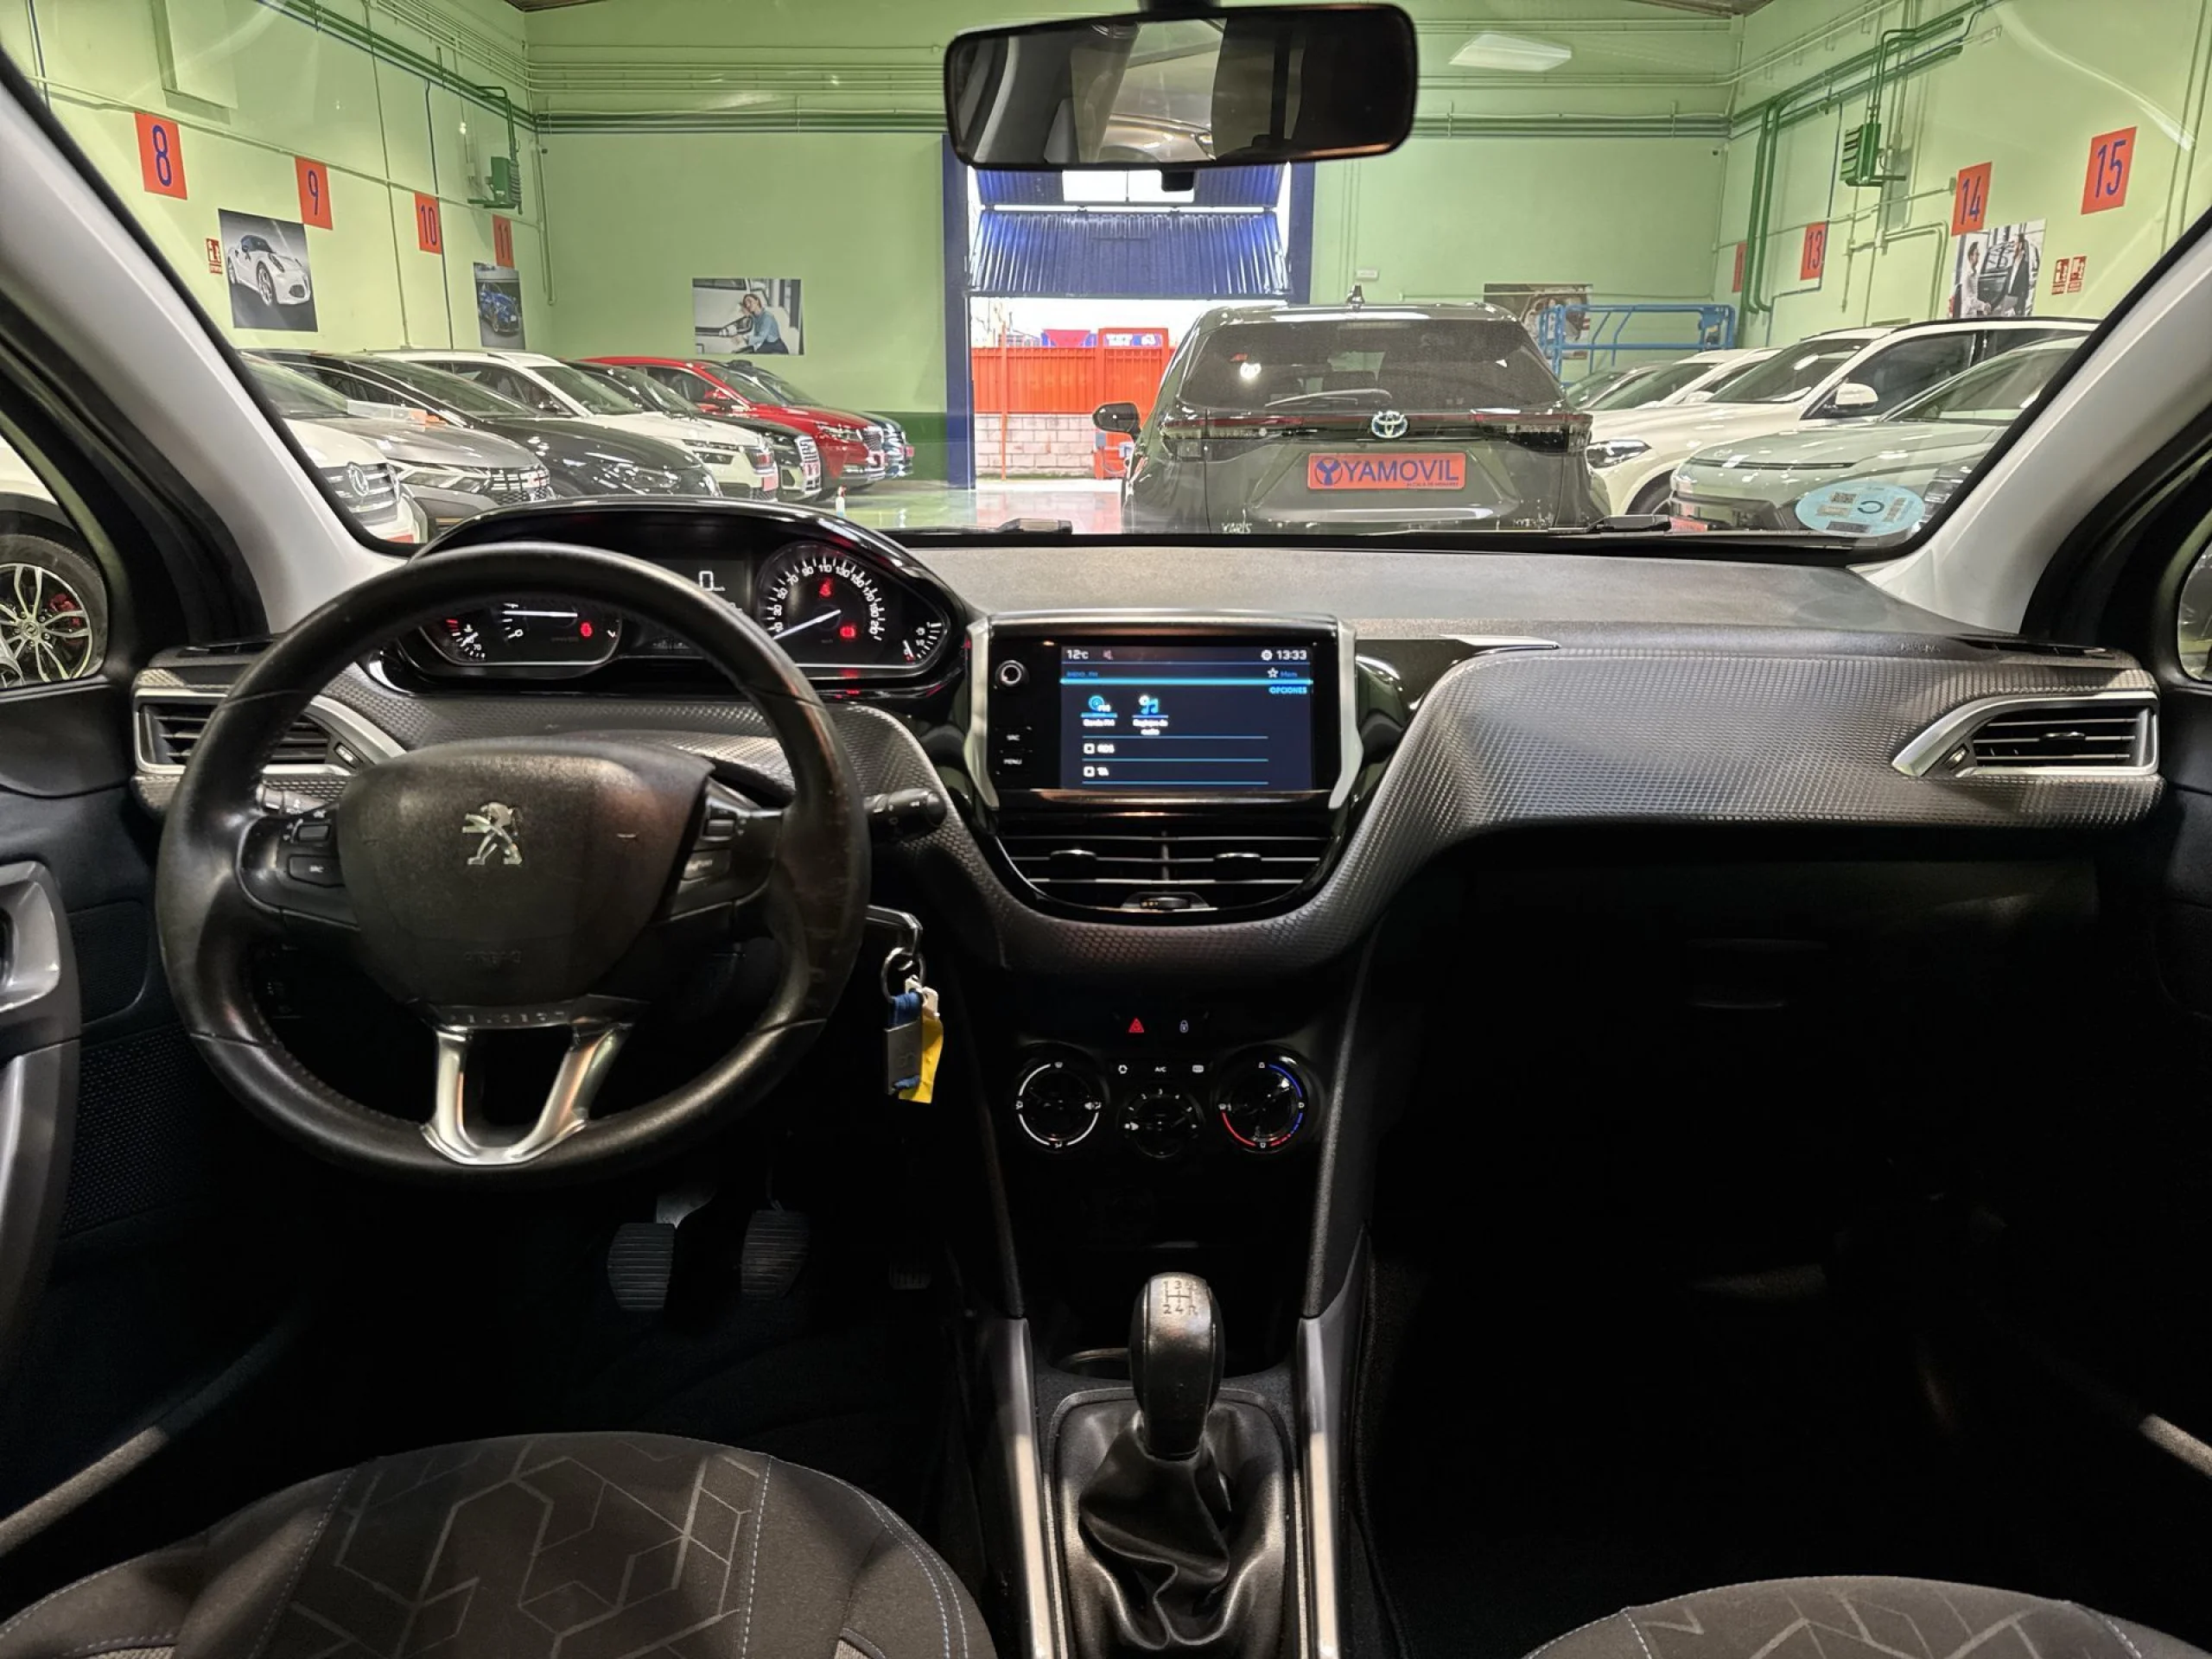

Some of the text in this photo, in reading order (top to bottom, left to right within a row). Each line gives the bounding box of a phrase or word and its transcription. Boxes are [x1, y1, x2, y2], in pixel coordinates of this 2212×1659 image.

[152, 124, 173, 188] 8
[2095, 139, 2126, 198] 15
[308, 169, 319, 215] 9
[1960, 175, 1981, 225] 14
[421, 204, 437, 245] 10
[499, 223, 512, 259] 11
[1806, 230, 1824, 271] 13
[1342, 460, 1459, 481] YAMOVIL
[1276, 649, 1307, 660] 13:33
[1269, 686, 1308, 695] OPCIONES
[1163, 1304, 1198, 1315] 2 4 R
